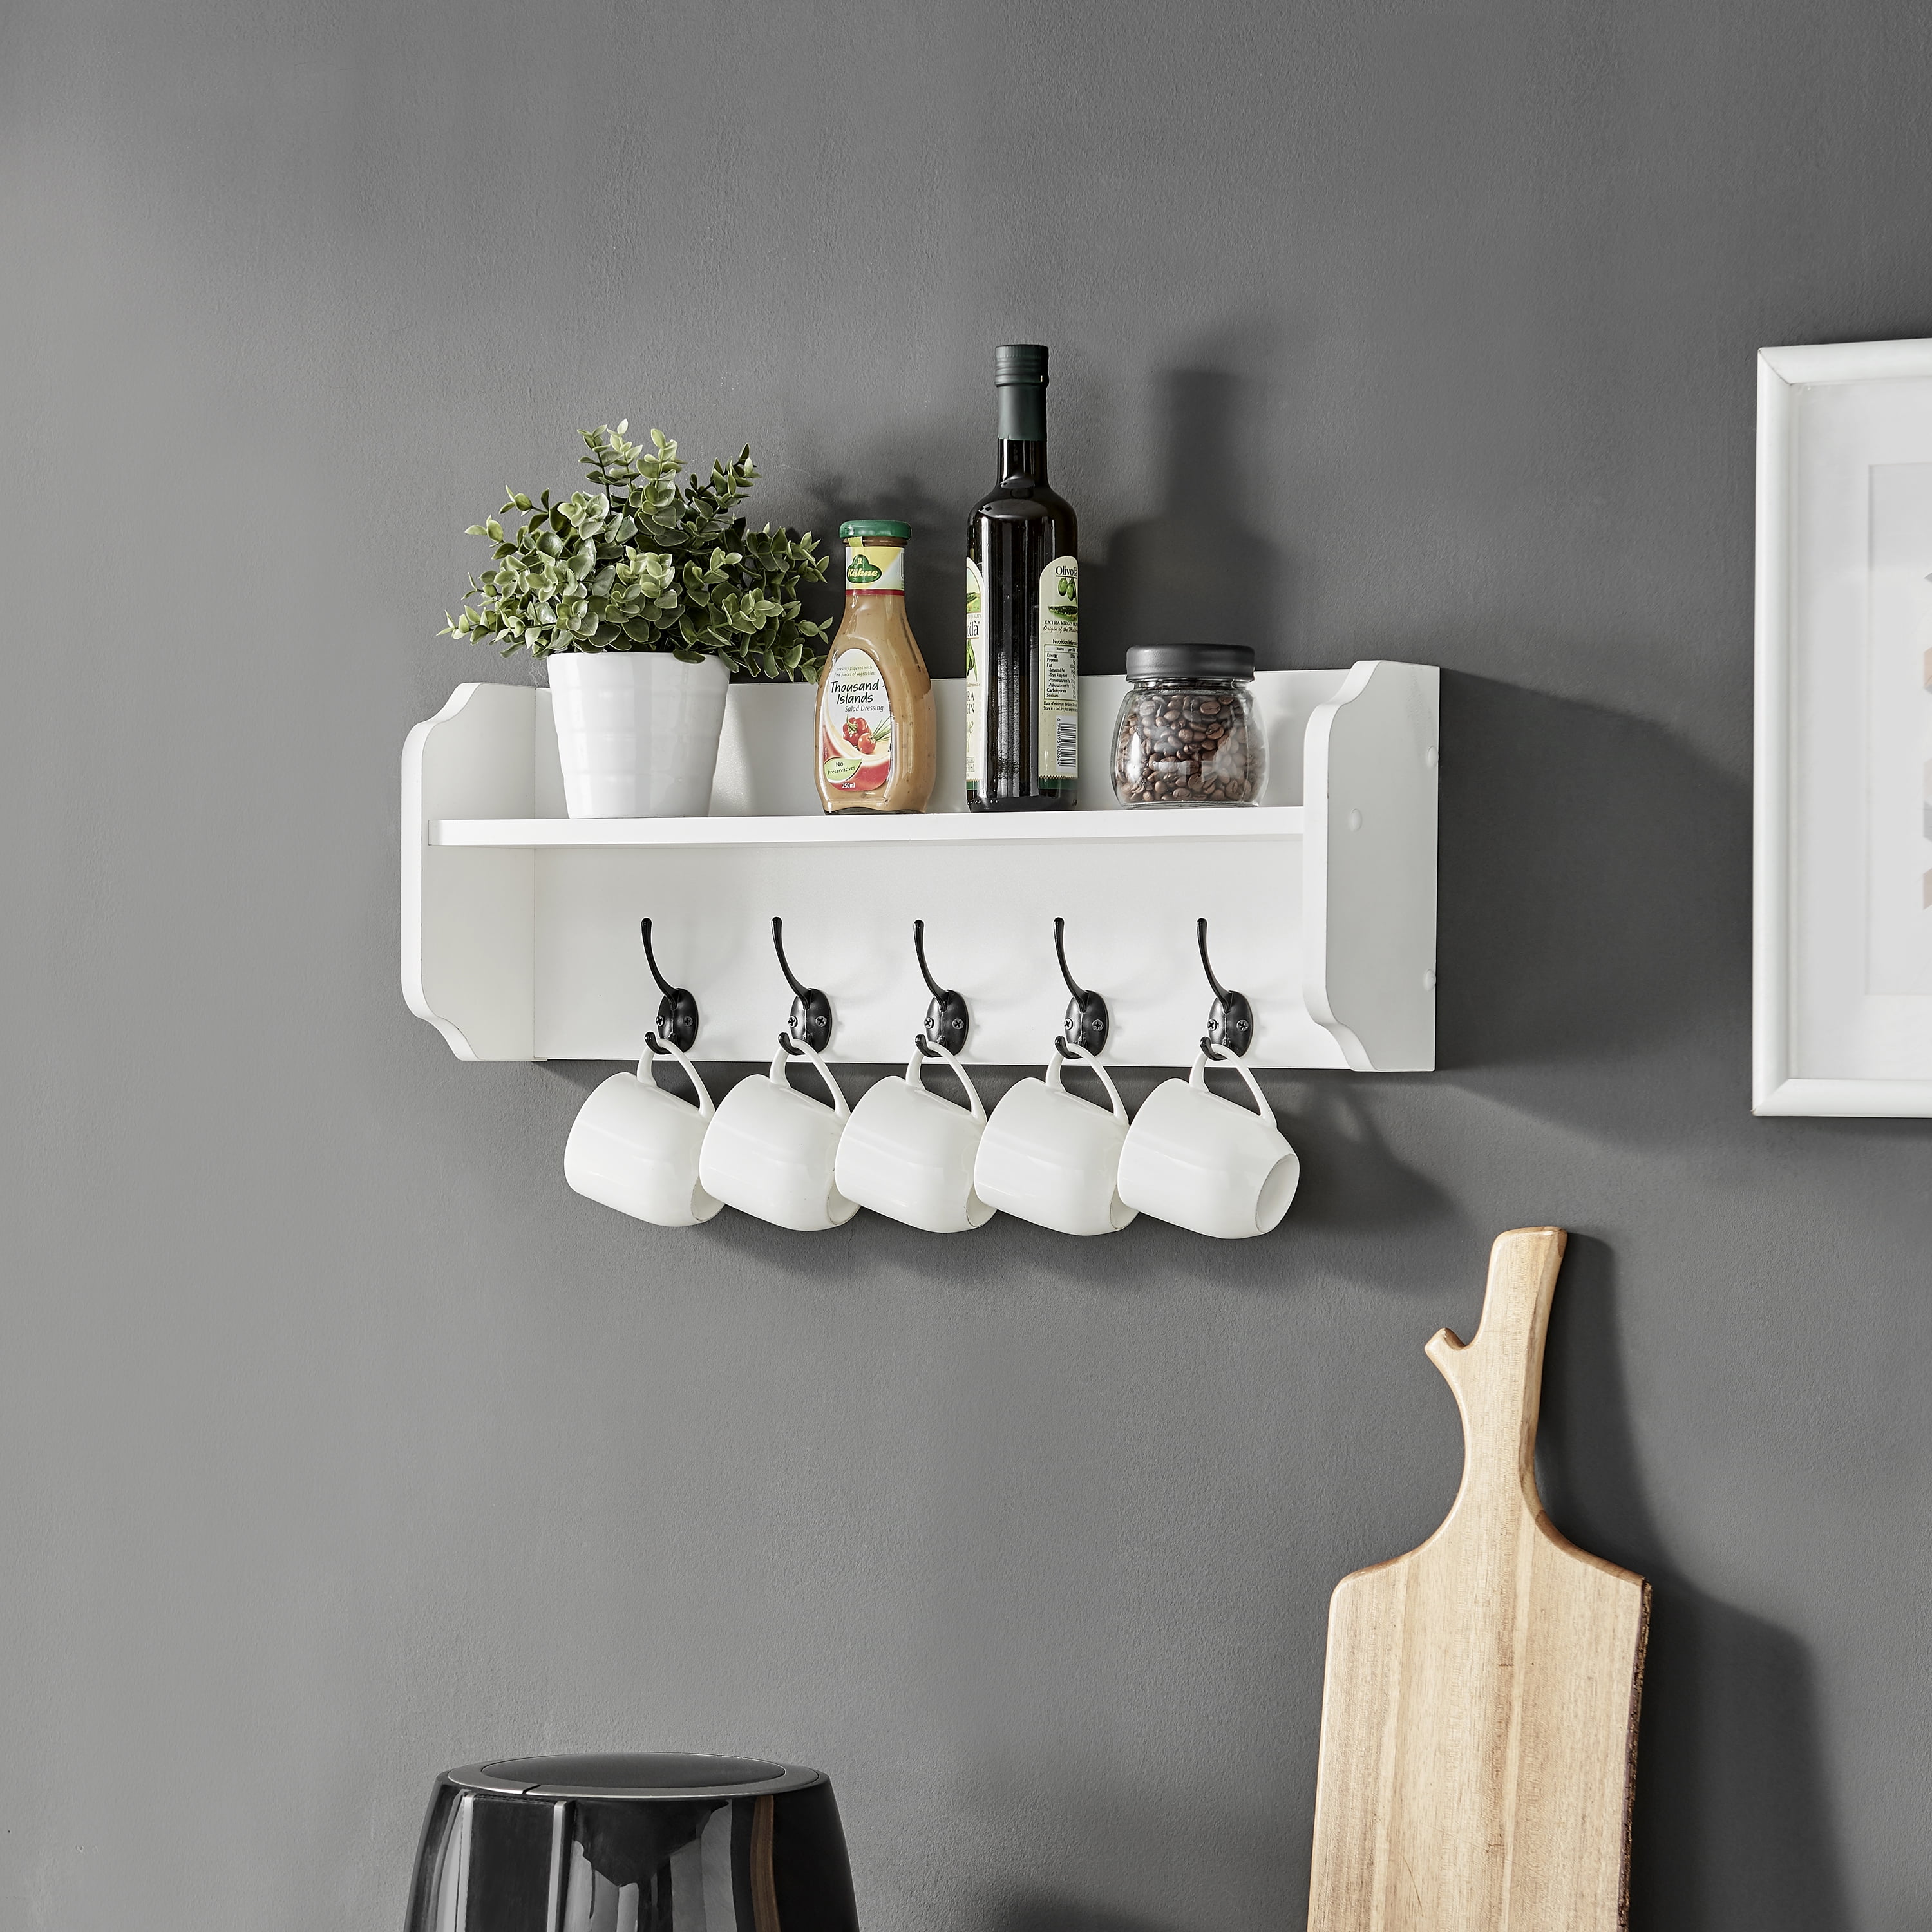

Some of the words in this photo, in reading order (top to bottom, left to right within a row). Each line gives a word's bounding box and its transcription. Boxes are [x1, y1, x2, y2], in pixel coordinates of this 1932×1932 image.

[848, 567, 878, 577] Kühne
[1043, 625, 1057, 633] Origin
[830, 679, 880, 693] Thousand
[837, 692, 874, 704] Islands
[828, 766, 856, 775] Preservatives
